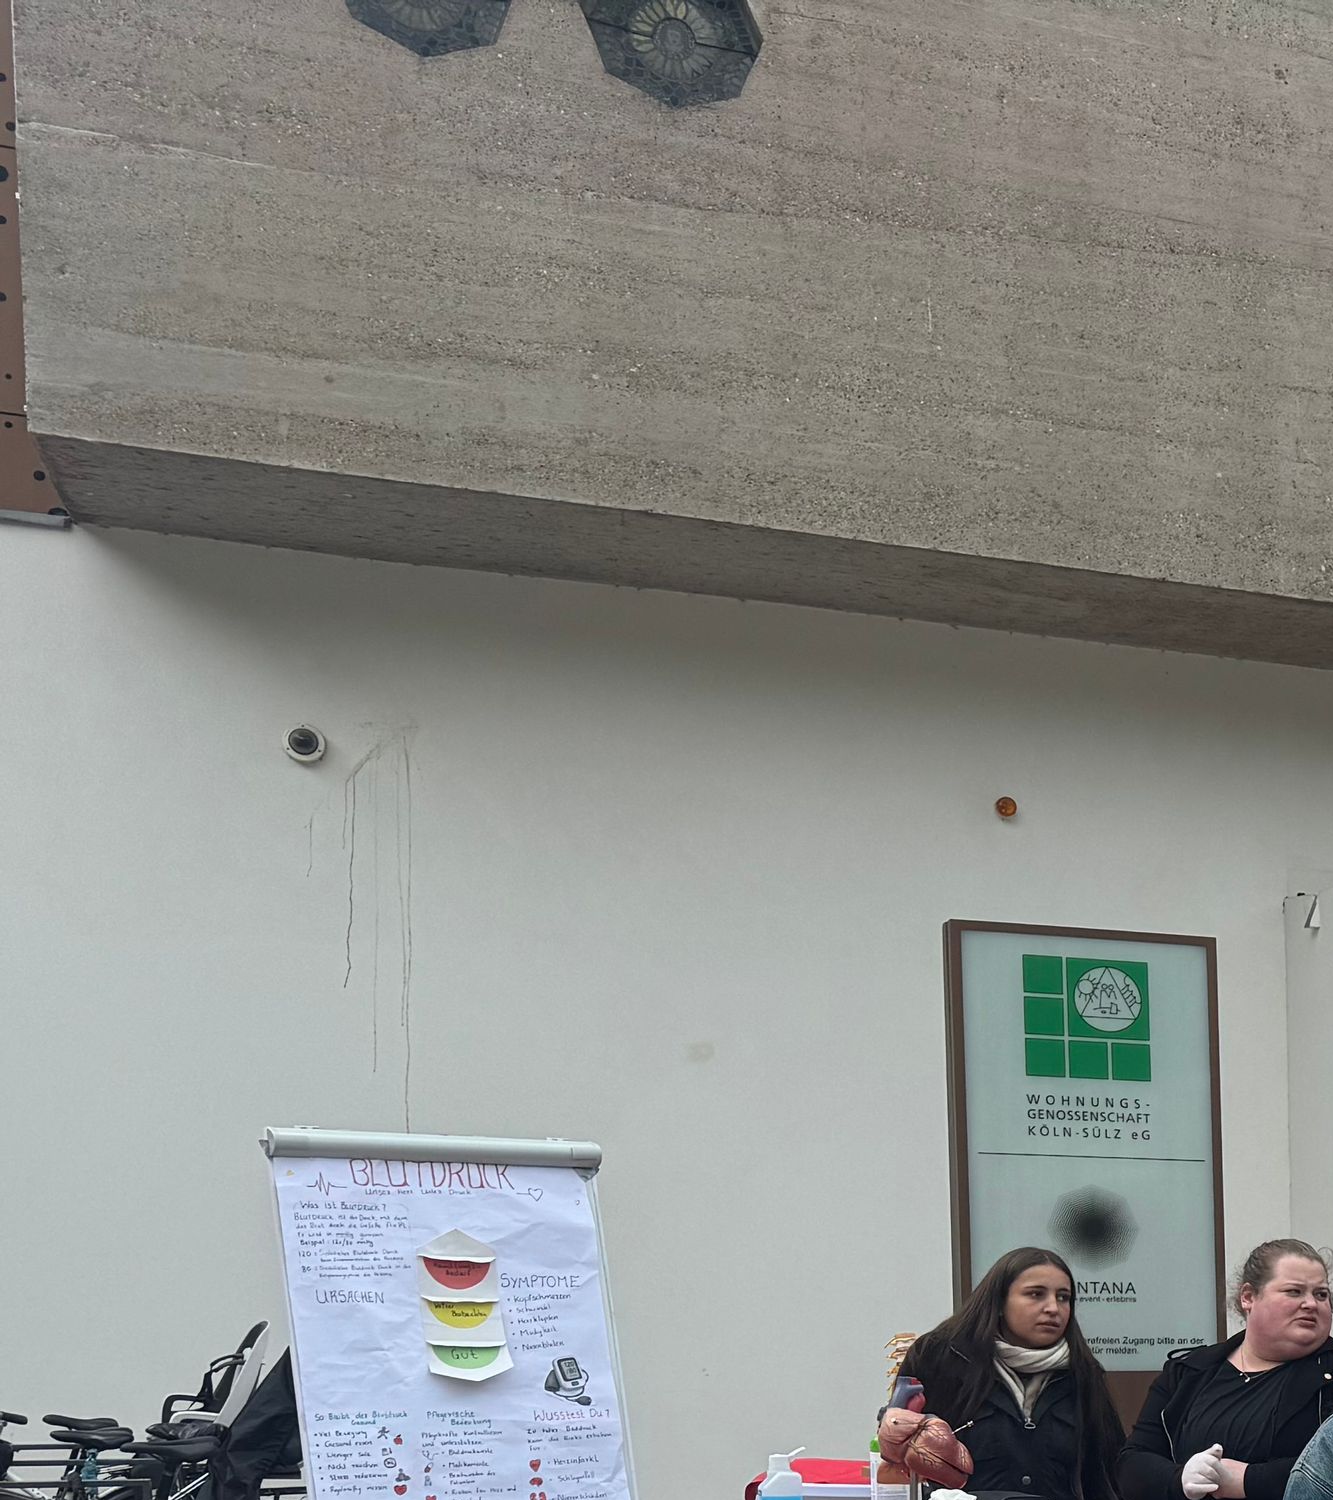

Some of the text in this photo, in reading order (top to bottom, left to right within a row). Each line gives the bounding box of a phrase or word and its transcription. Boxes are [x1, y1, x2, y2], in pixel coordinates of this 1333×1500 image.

[1026, 1093, 1150, 1109] WOHNUNGS-
[1027, 1108, 1151, 1124] GENOSSENSCHAFT
[1028, 1124, 1151, 1140] KÖLN-SÜLZ eG
[350, 1158, 515, 1190] BLUTDRUCK
[500, 1273, 581, 1288] SYMPTOME
[1076, 1281, 1137, 1295] NTANA
[315, 1289, 384, 1304] URSACHEN
[1122, 1336, 1155, 1346] Zugang
[450, 1348, 478, 1360] Gut
[1092, 1346, 1104, 1354] tür
[533, 1409, 585, 1421] Wusstest
